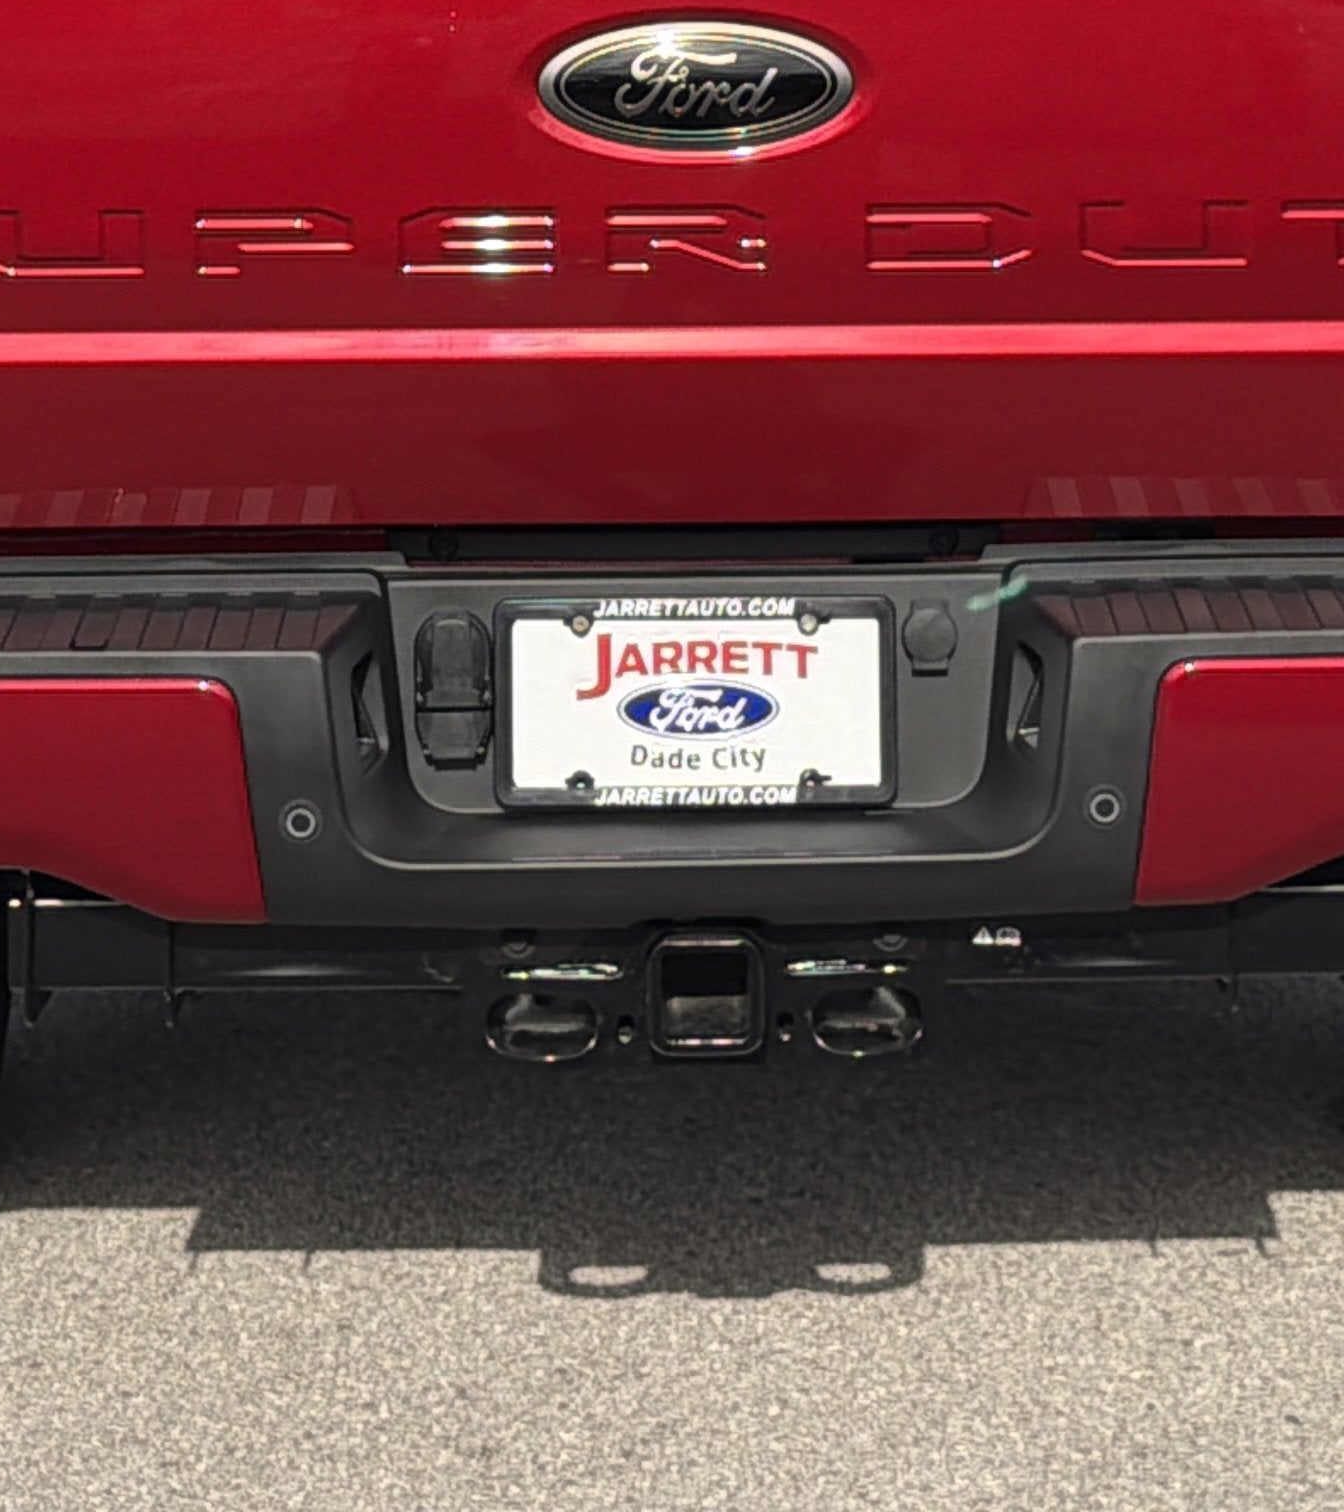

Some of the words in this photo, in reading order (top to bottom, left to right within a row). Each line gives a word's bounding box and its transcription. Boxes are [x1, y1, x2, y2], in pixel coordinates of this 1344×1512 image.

[613, 42, 779, 118] Ford
[593, 597, 796, 618] JARRETTAUTO.COM
[575, 633, 819, 701] JARRETT
[650, 686, 745, 732] Ford
[630, 744, 702, 771] Dade
[712, 745, 767, 772] City
[593, 786, 797, 807] JARRETTAUTO.COM
